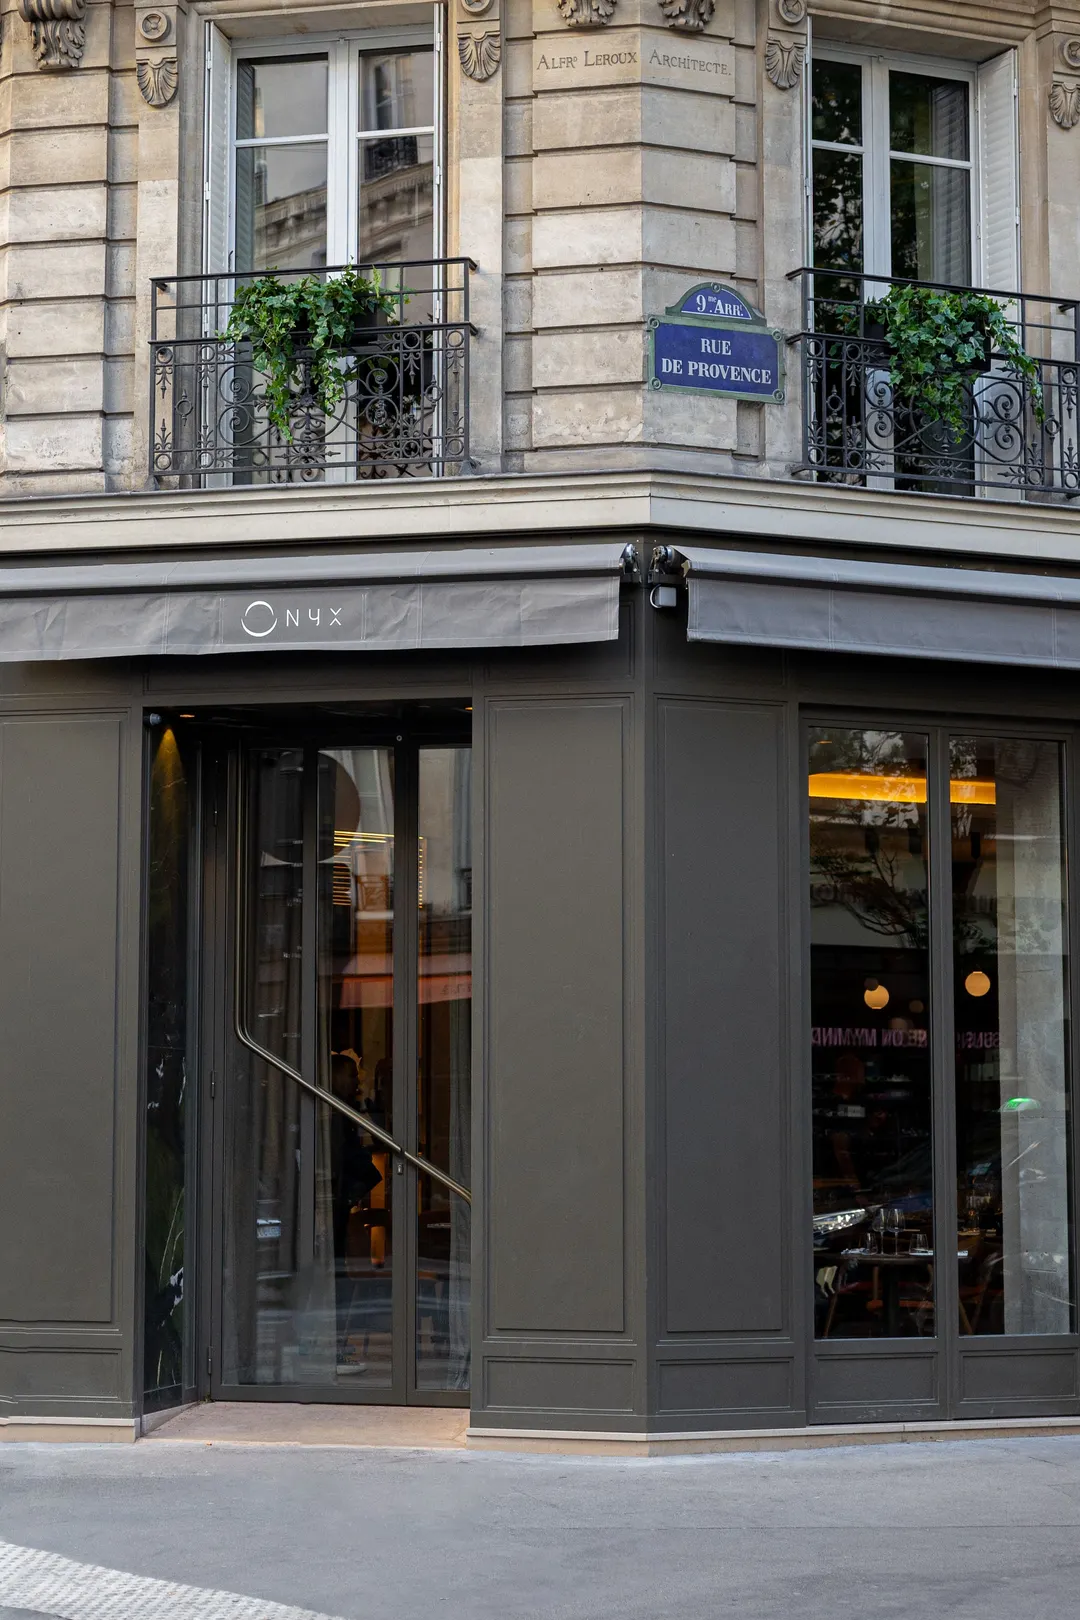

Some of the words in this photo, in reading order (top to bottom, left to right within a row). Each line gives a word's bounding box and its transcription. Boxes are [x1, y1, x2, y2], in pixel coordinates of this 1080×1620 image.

[584, 51, 638, 67] LEROUX
[701, 338, 732, 356] RUE
[661, 358, 683, 374] DE
[687, 360, 772, 385] PROVENCE
